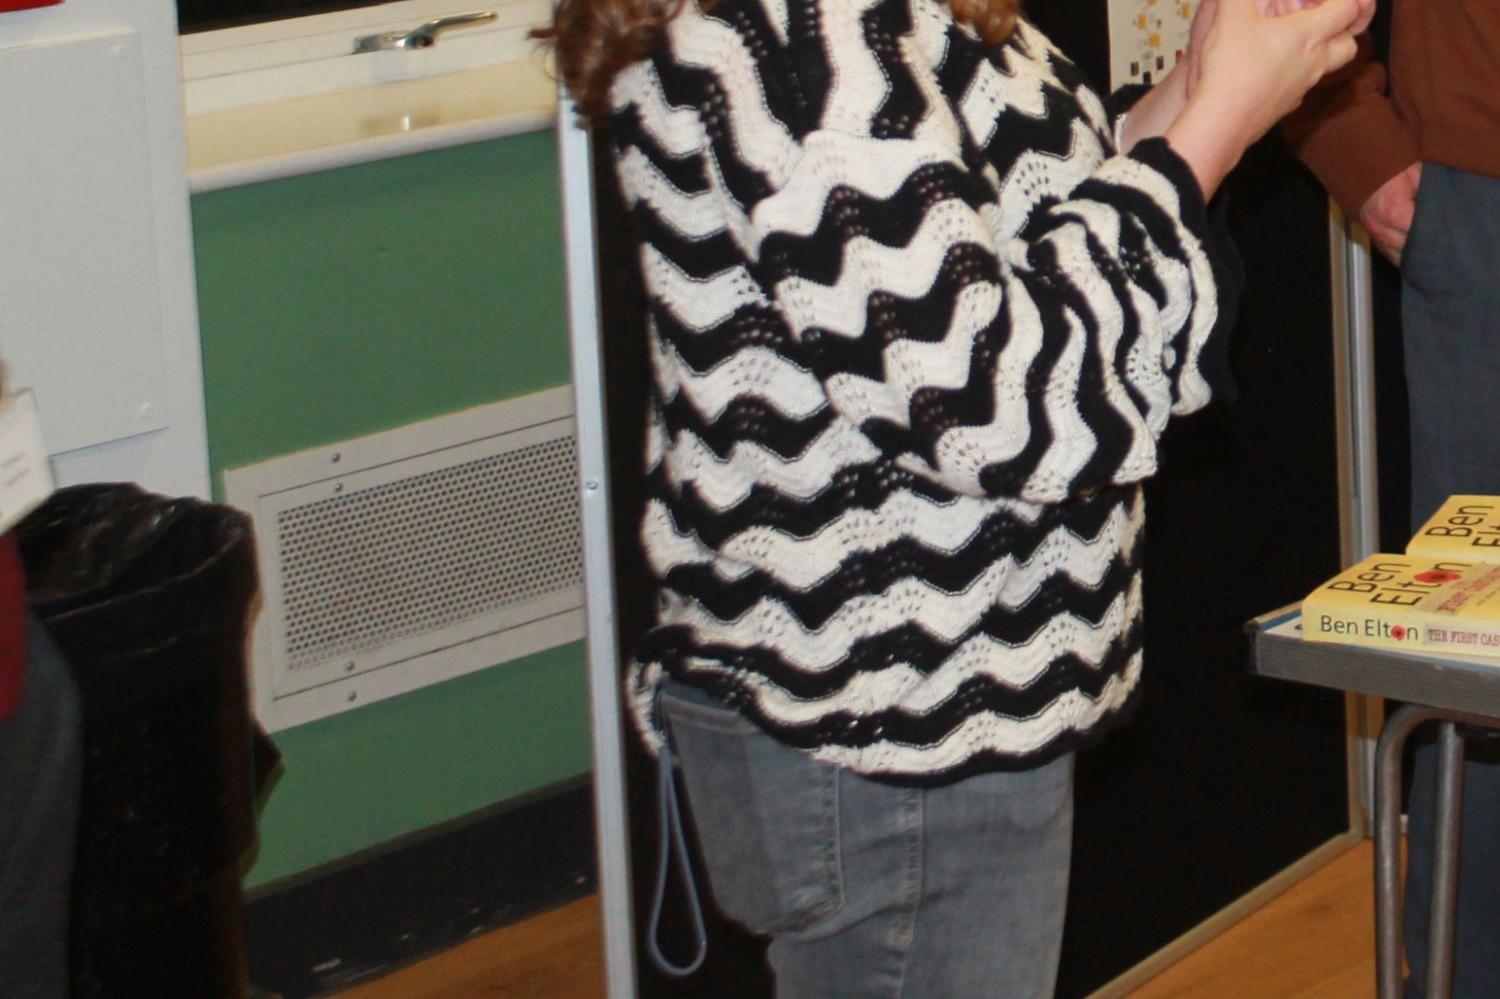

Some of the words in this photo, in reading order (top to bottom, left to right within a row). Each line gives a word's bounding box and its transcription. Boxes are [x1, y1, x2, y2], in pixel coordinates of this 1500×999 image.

[1424, 505, 1494, 538] Ben
[1327, 562, 1411, 594] Ben
[1320, 615, 1358, 635] Ben
[1365, 618, 1418, 641] Elton
[1428, 628, 1448, 642] THE
[1451, 630, 1479, 645] FIRST
